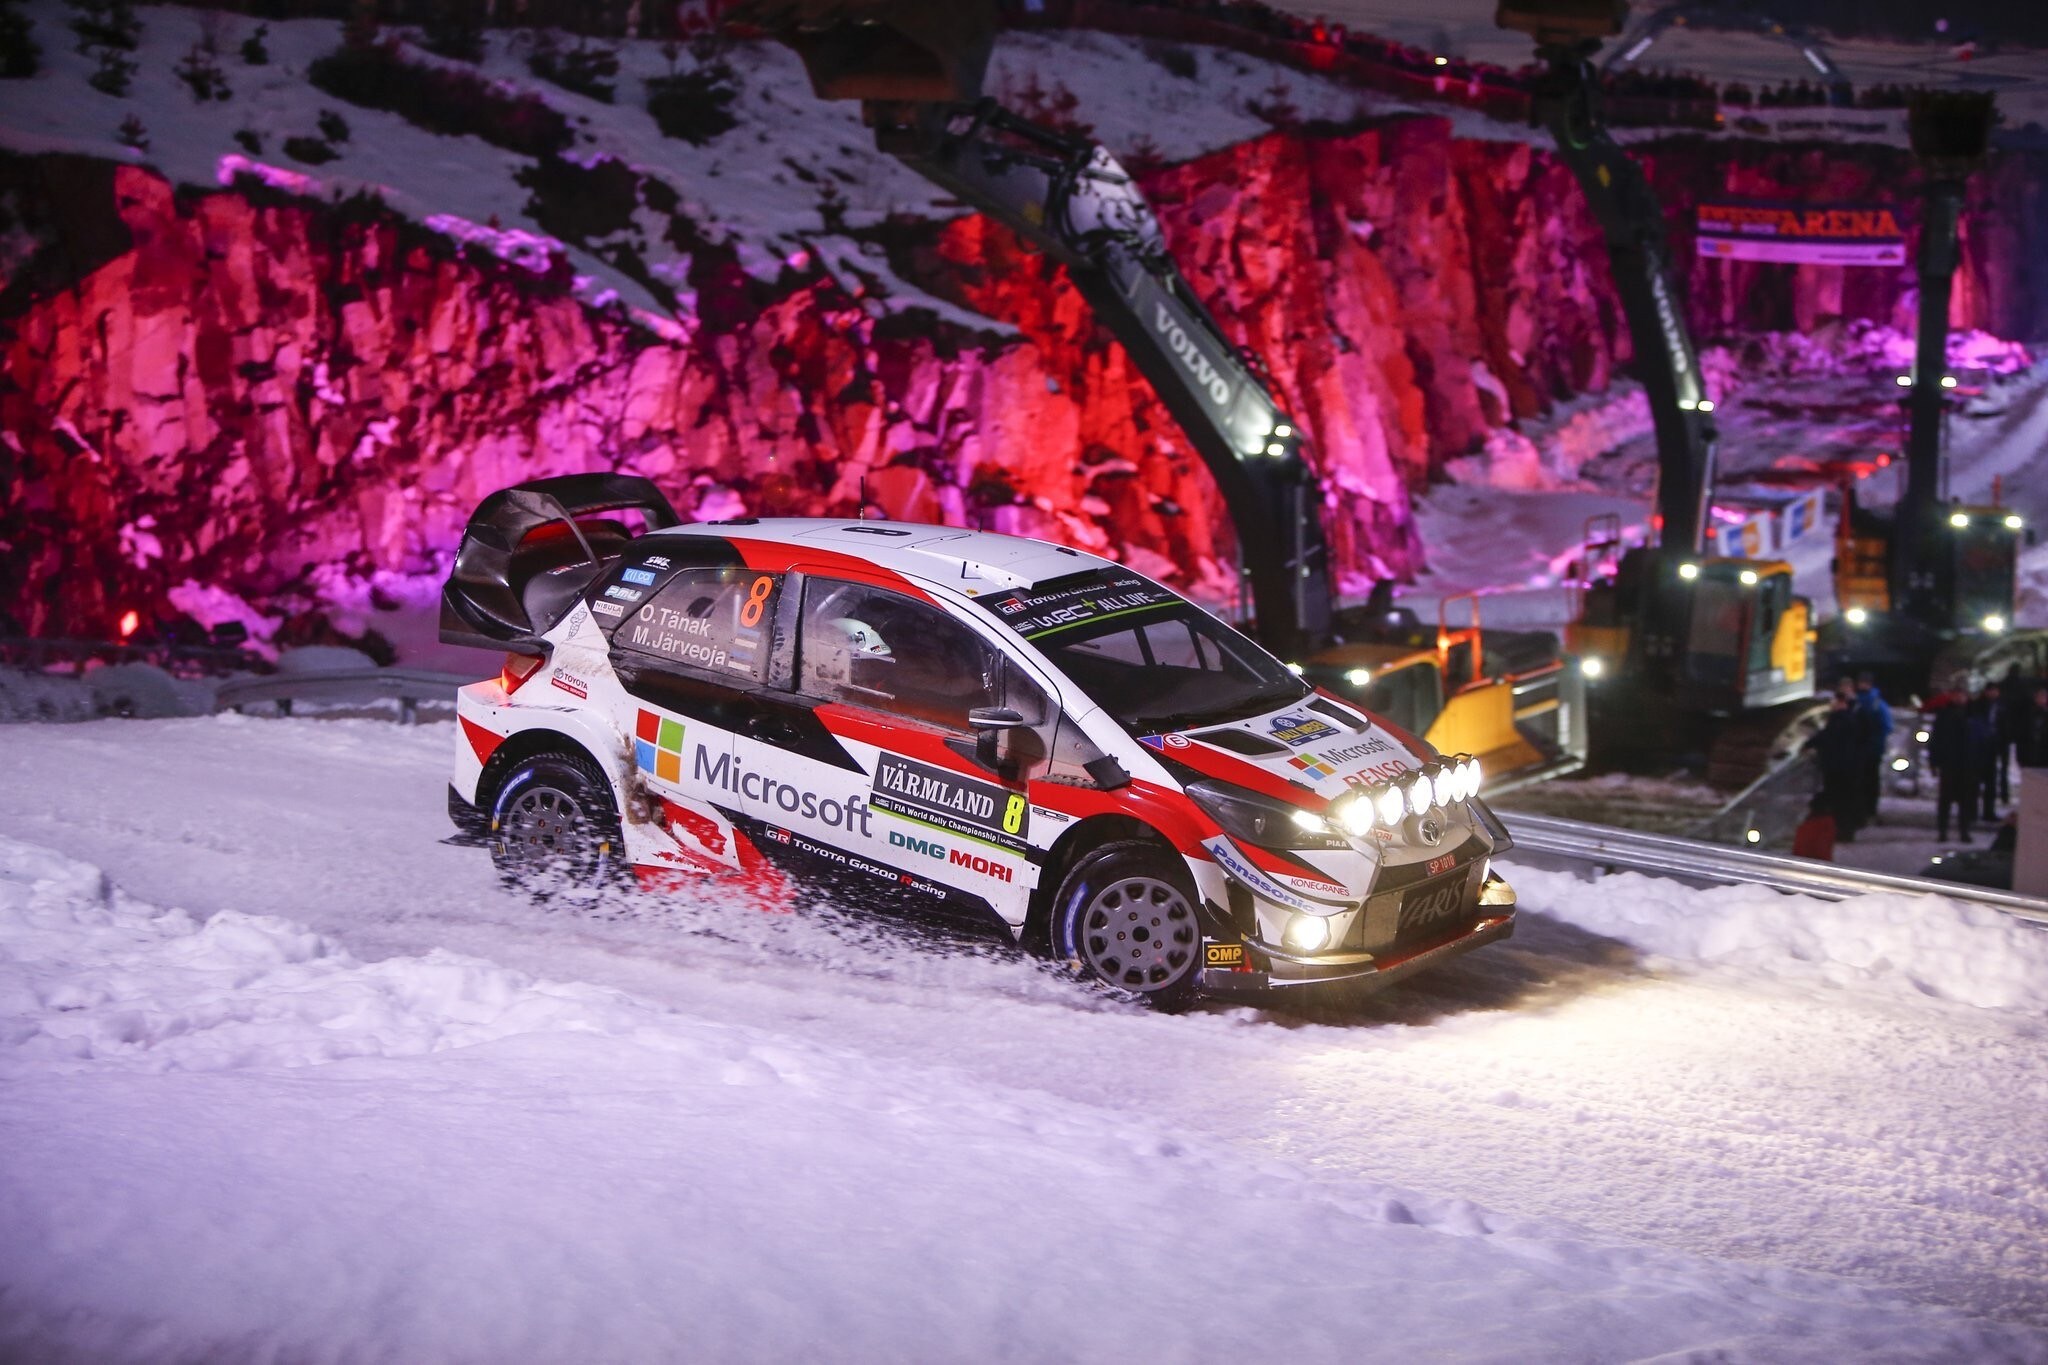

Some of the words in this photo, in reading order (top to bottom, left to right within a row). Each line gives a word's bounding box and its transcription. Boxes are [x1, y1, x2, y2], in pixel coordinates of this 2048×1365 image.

[1778, 209, 1900, 237] ARENA
[1156, 301, 1230, 406] VOLVO
[595, 602, 622, 612] NISULA
[740, 576, 774, 628] 8
[999, 600, 1026, 615] GR
[1023, 592, 1070, 607] TOYOTA
[1097, 597, 1129, 611] ALL
[1119, 592, 1155, 607] LIVE
[640, 603, 712, 638] O.Tänak
[631, 625, 727, 667] M.Järveoja
[564, 673, 588, 690] TOYOTA
[1318, 737, 1395, 766] Microsoft
[694, 743, 873, 838] Microsoft
[881, 763, 995, 819] VÄRMLAND
[1002, 793, 1027, 834] 8
[894, 803, 906, 813] FIA
[907, 807, 928, 820] World
[929, 814, 947, 826] Rally
[948, 820, 997, 842] Championship
[889, 831, 946, 860] DMG
[949, 849, 1013, 883] MORI
[1326, 839, 1348, 848] PIAA
[765, 826, 791, 845] GR
[793, 838, 846, 864] TOYOTA
[849, 858, 899, 882] GAZOO
[900, 874, 947, 900] Racing
[1212, 844, 1316, 913] Panasonic
[1429, 861, 1438, 873] SP
[1290, 878, 1350, 897] KONECRANES
[1207, 947, 1242, 961] OMP
